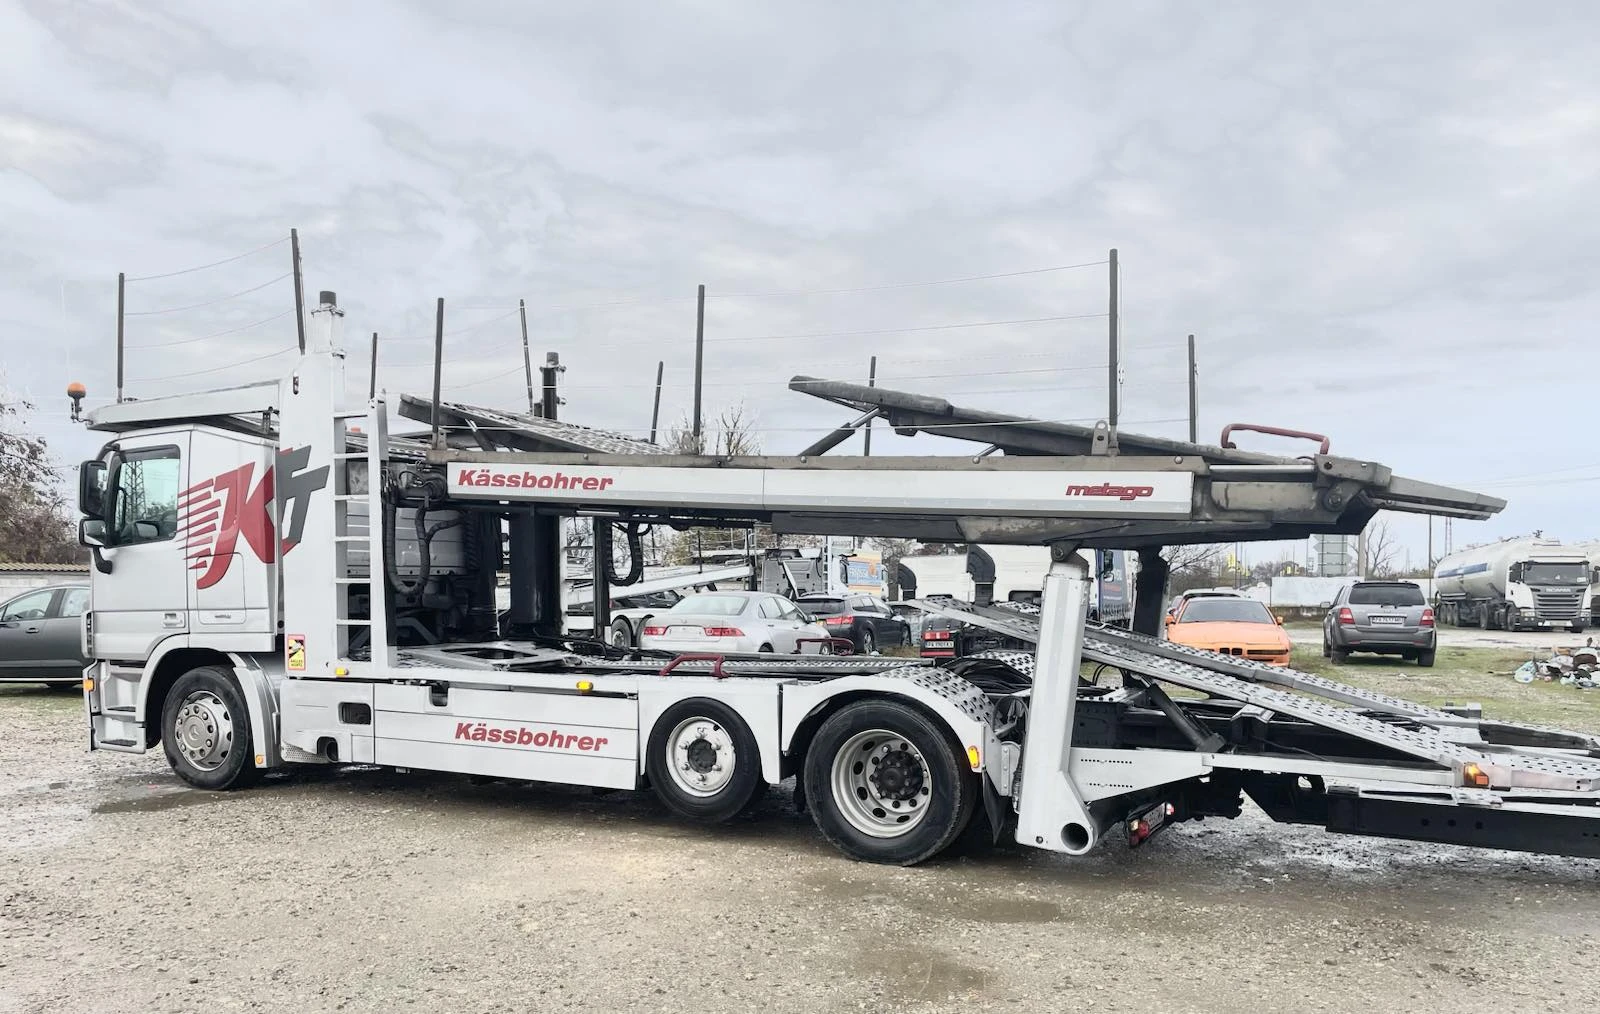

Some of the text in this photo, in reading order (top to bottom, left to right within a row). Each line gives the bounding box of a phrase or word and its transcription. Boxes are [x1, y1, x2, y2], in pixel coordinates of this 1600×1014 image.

[458, 469, 613, 491] Kässbohrer
[1065, 483, 1154, 500] metago
[455, 722, 608, 751] Kässbohrer
